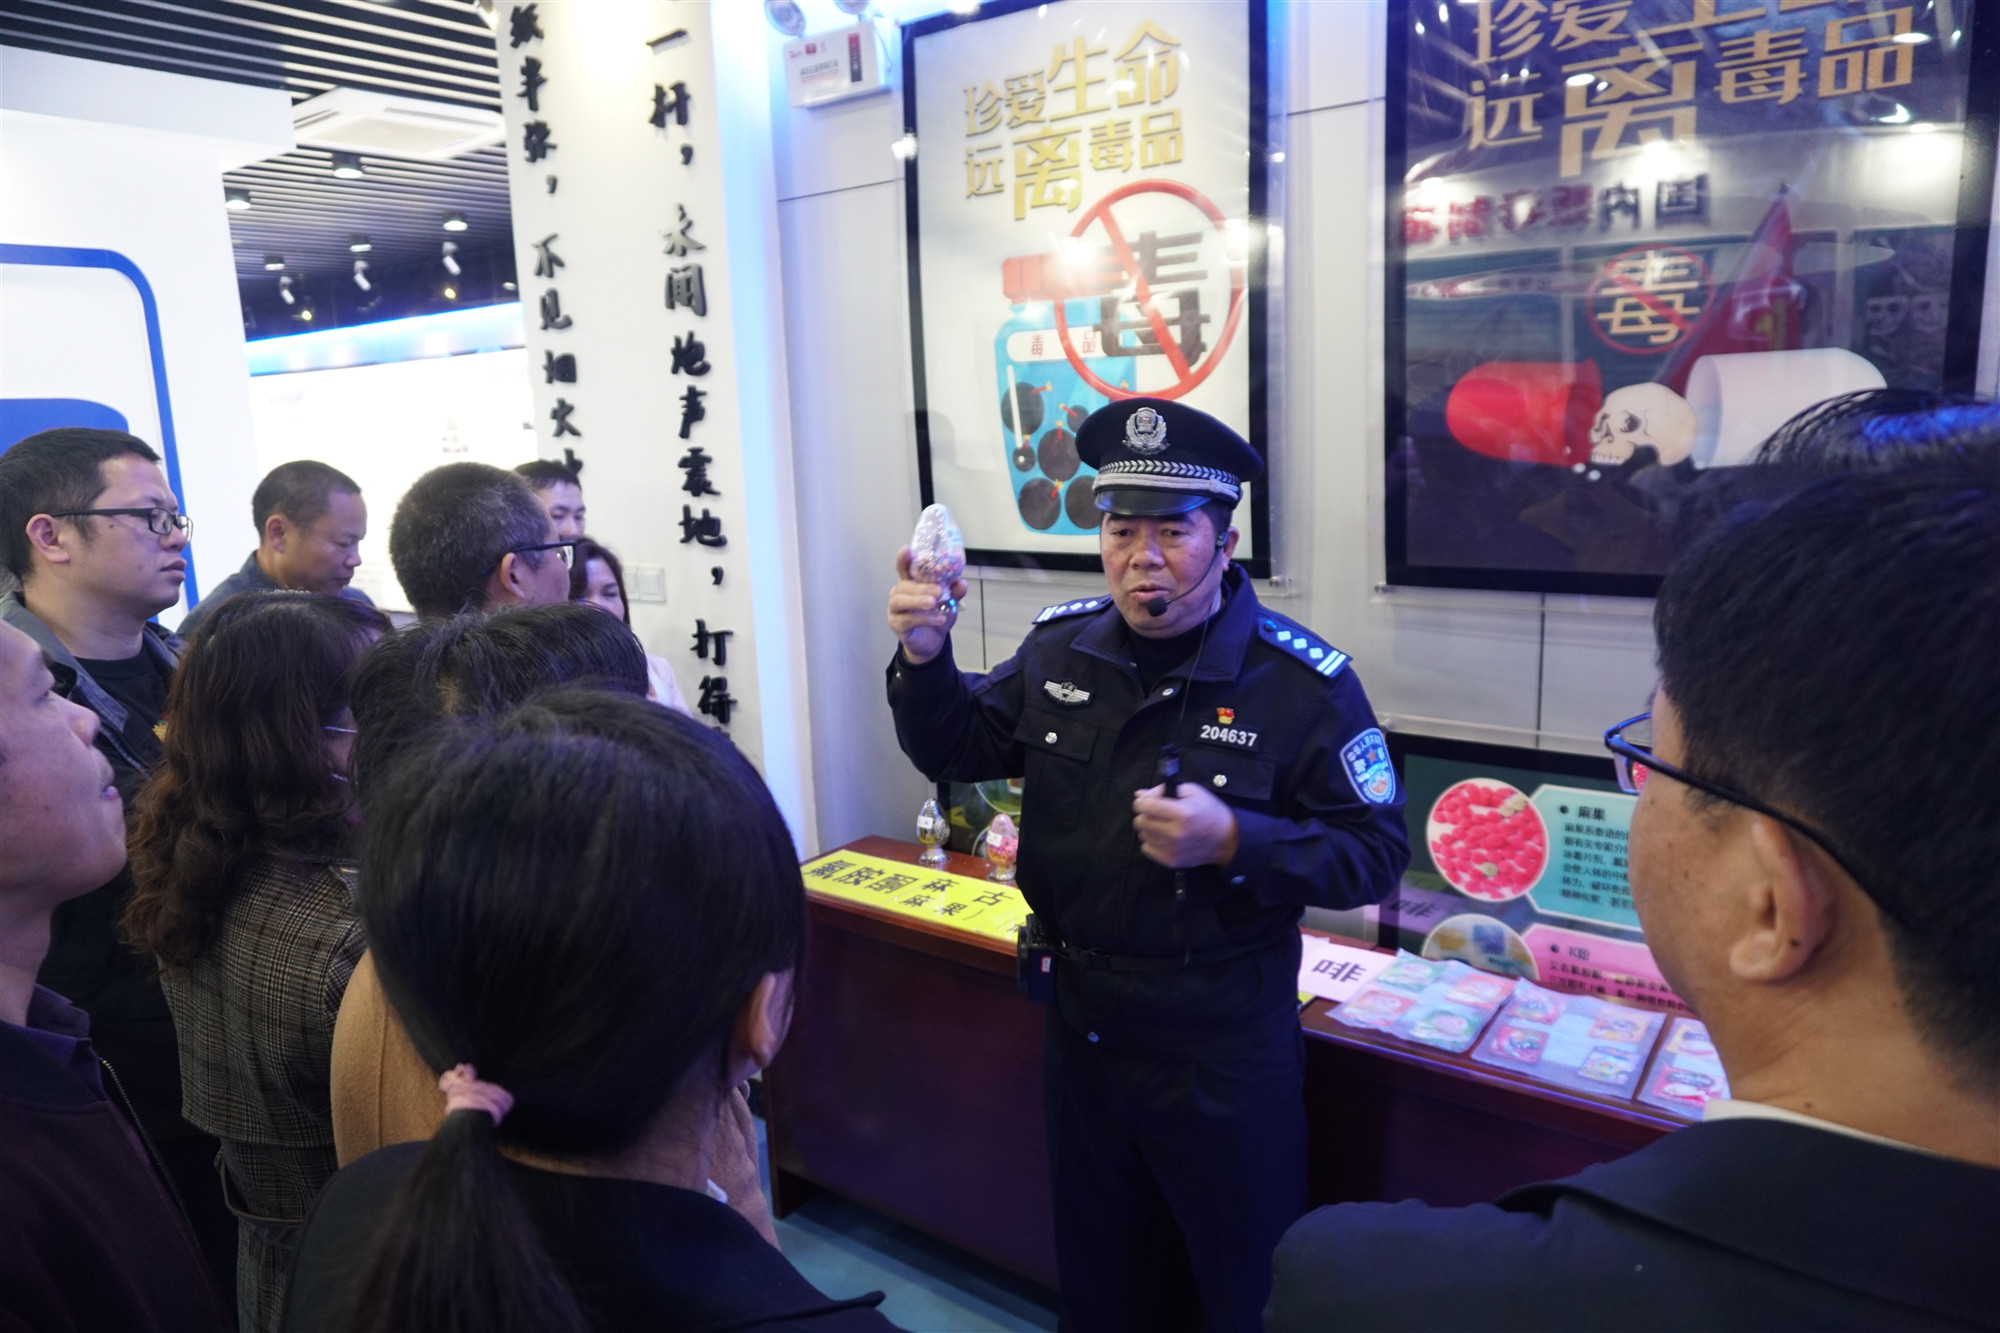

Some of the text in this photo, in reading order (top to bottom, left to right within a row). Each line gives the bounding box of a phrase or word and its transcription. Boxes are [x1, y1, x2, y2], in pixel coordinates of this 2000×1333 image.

[1471, 0, 1866, 66] 珍爱
[964, 19, 1182, 138] 珍爱生命
[1468, 6, 1914, 178] 远离毒品
[965, 108, 1184, 221] 远离毒品
[1200, 724, 1258, 748] 204637
[1577, 806, 1606, 822] 麻果
[921, 877, 1015, 907] 麻古
[1569, 946, 1591, 961] K粉
[1311, 958, 1368, 983] 啡
